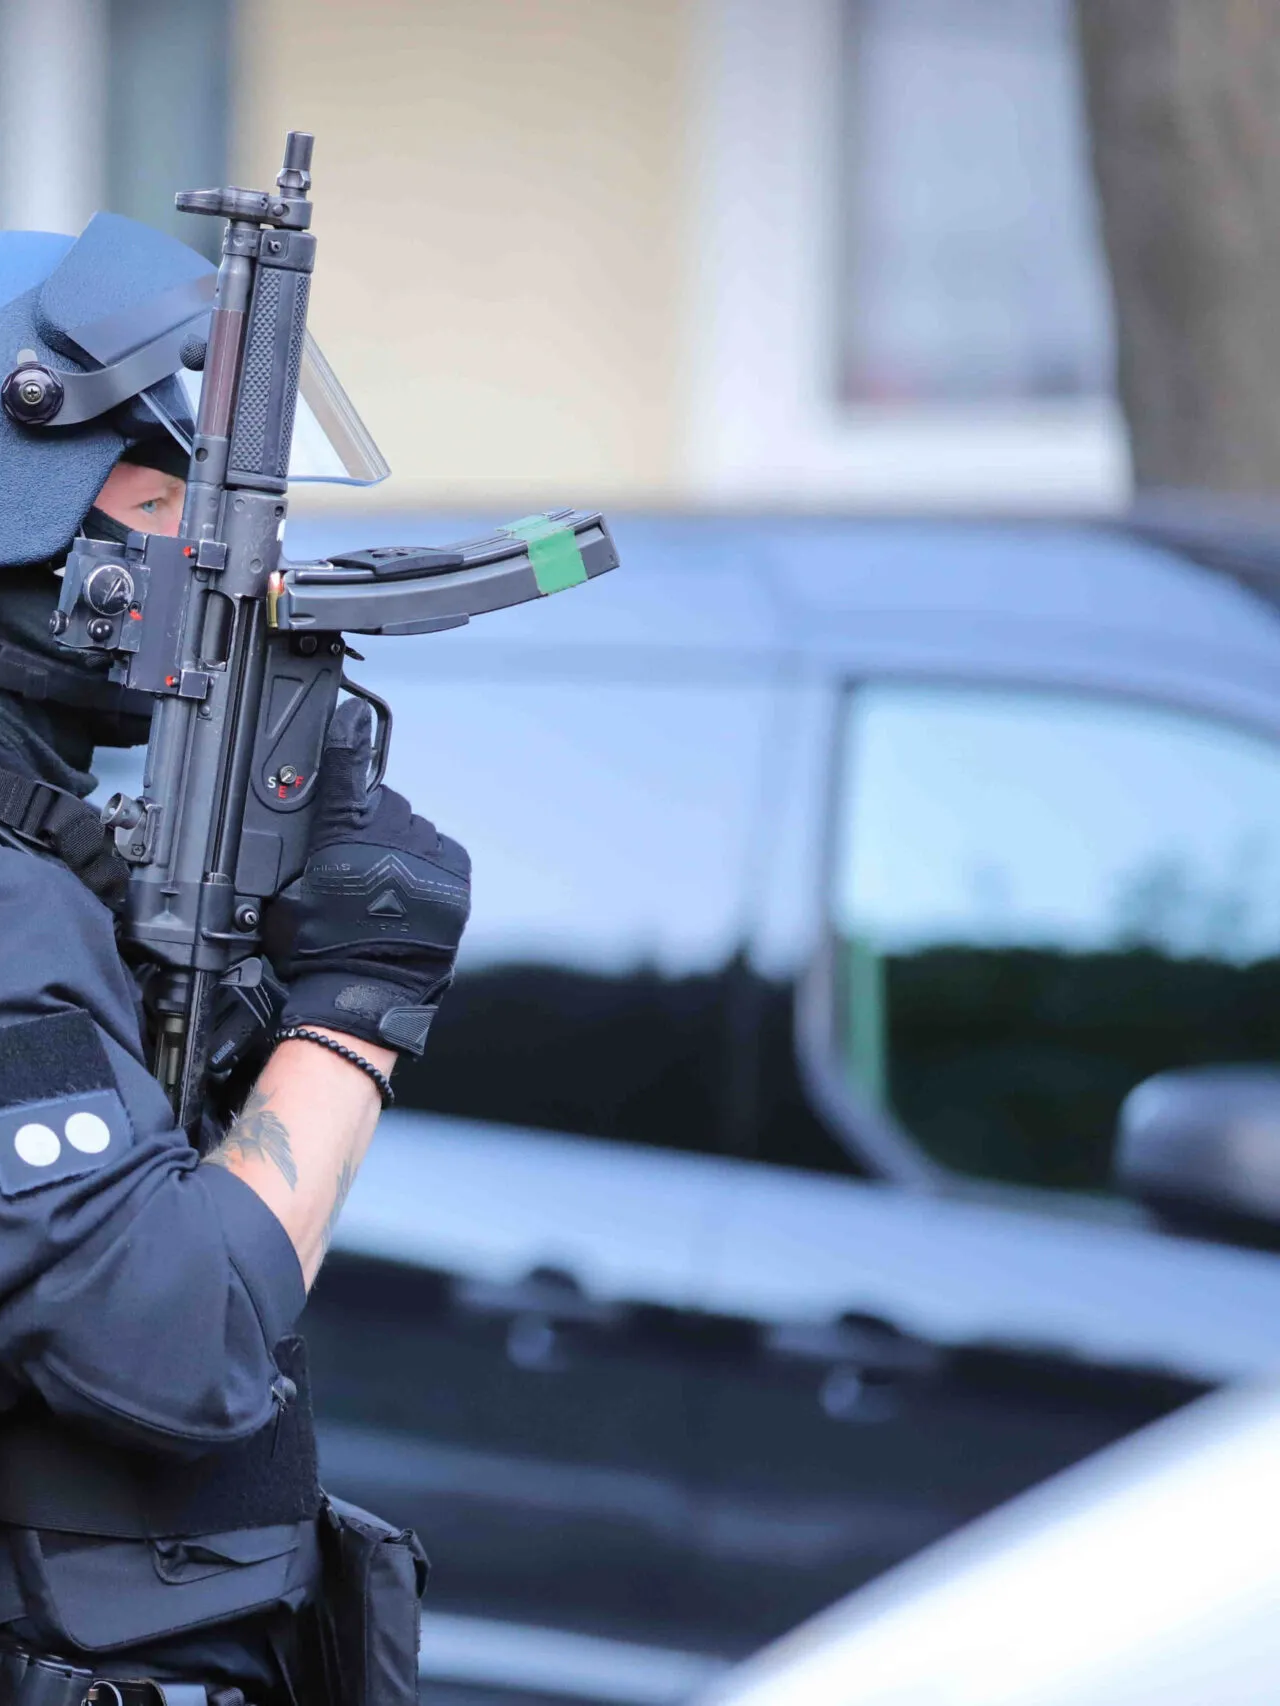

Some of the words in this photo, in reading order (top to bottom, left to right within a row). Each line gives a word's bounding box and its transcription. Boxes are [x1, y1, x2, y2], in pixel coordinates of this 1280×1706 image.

[268, 776, 276, 788] S
[279, 786, 288, 798] E
[295, 776, 304, 788] F
